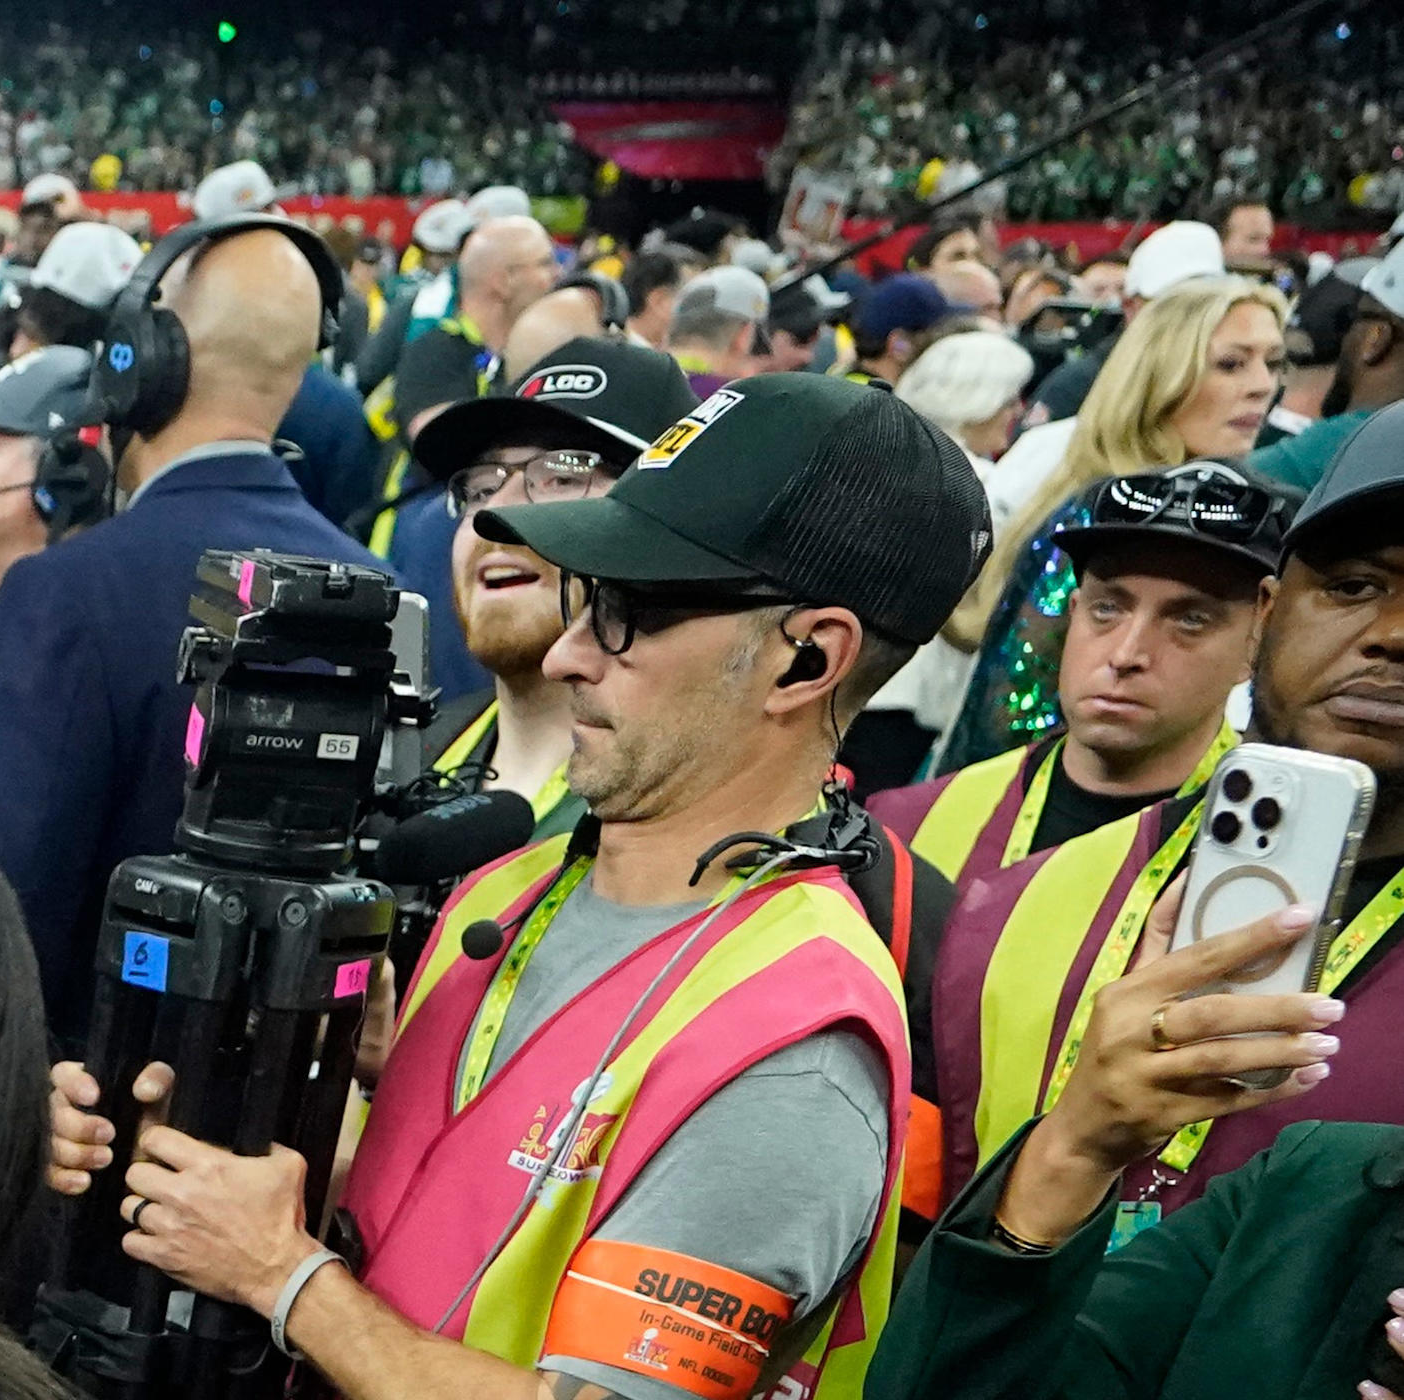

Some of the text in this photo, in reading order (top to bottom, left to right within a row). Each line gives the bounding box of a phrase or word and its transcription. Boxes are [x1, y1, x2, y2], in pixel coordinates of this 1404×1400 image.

[246, 733, 351, 754] arrow 55
[133, 941, 148, 966] 6
[635, 1268, 782, 1341] SUPER BO
[639, 1308, 706, 1342] In-Game
[708, 1332, 741, 1356] Field
